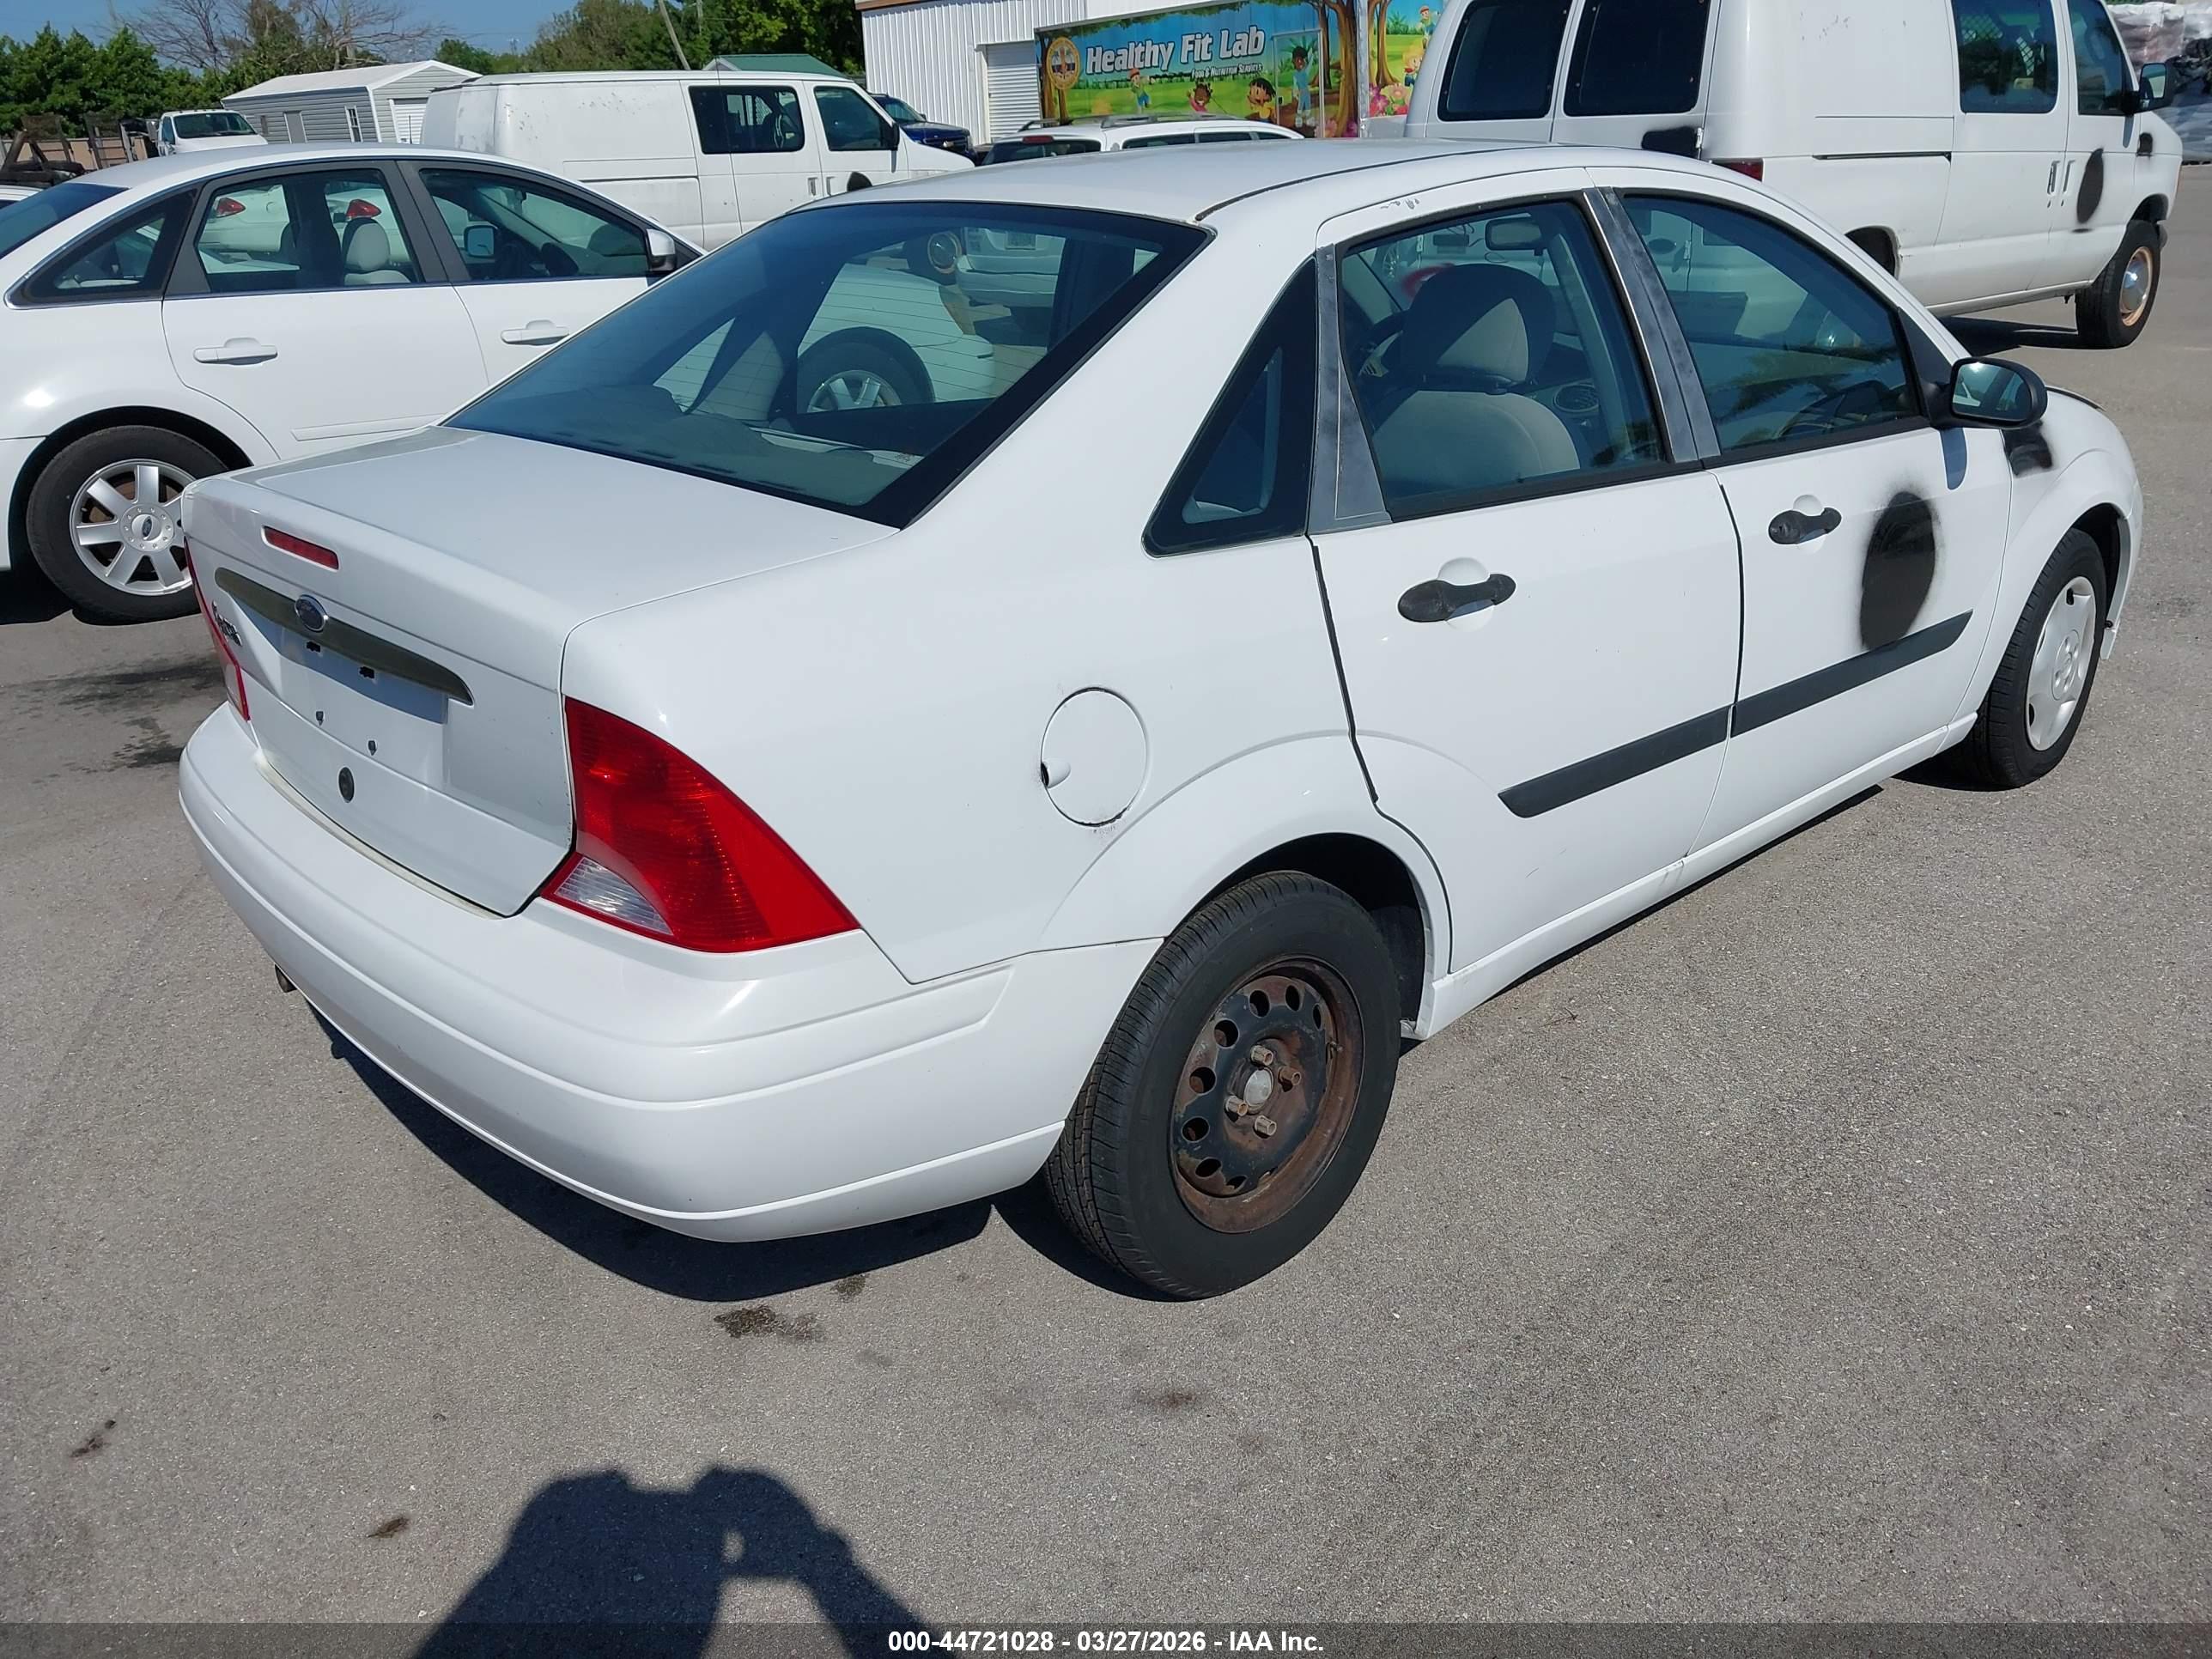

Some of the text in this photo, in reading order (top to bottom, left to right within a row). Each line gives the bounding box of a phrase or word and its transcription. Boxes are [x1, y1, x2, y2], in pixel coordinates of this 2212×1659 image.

[1085, 25, 1266, 75] Healthy Fit Lab
